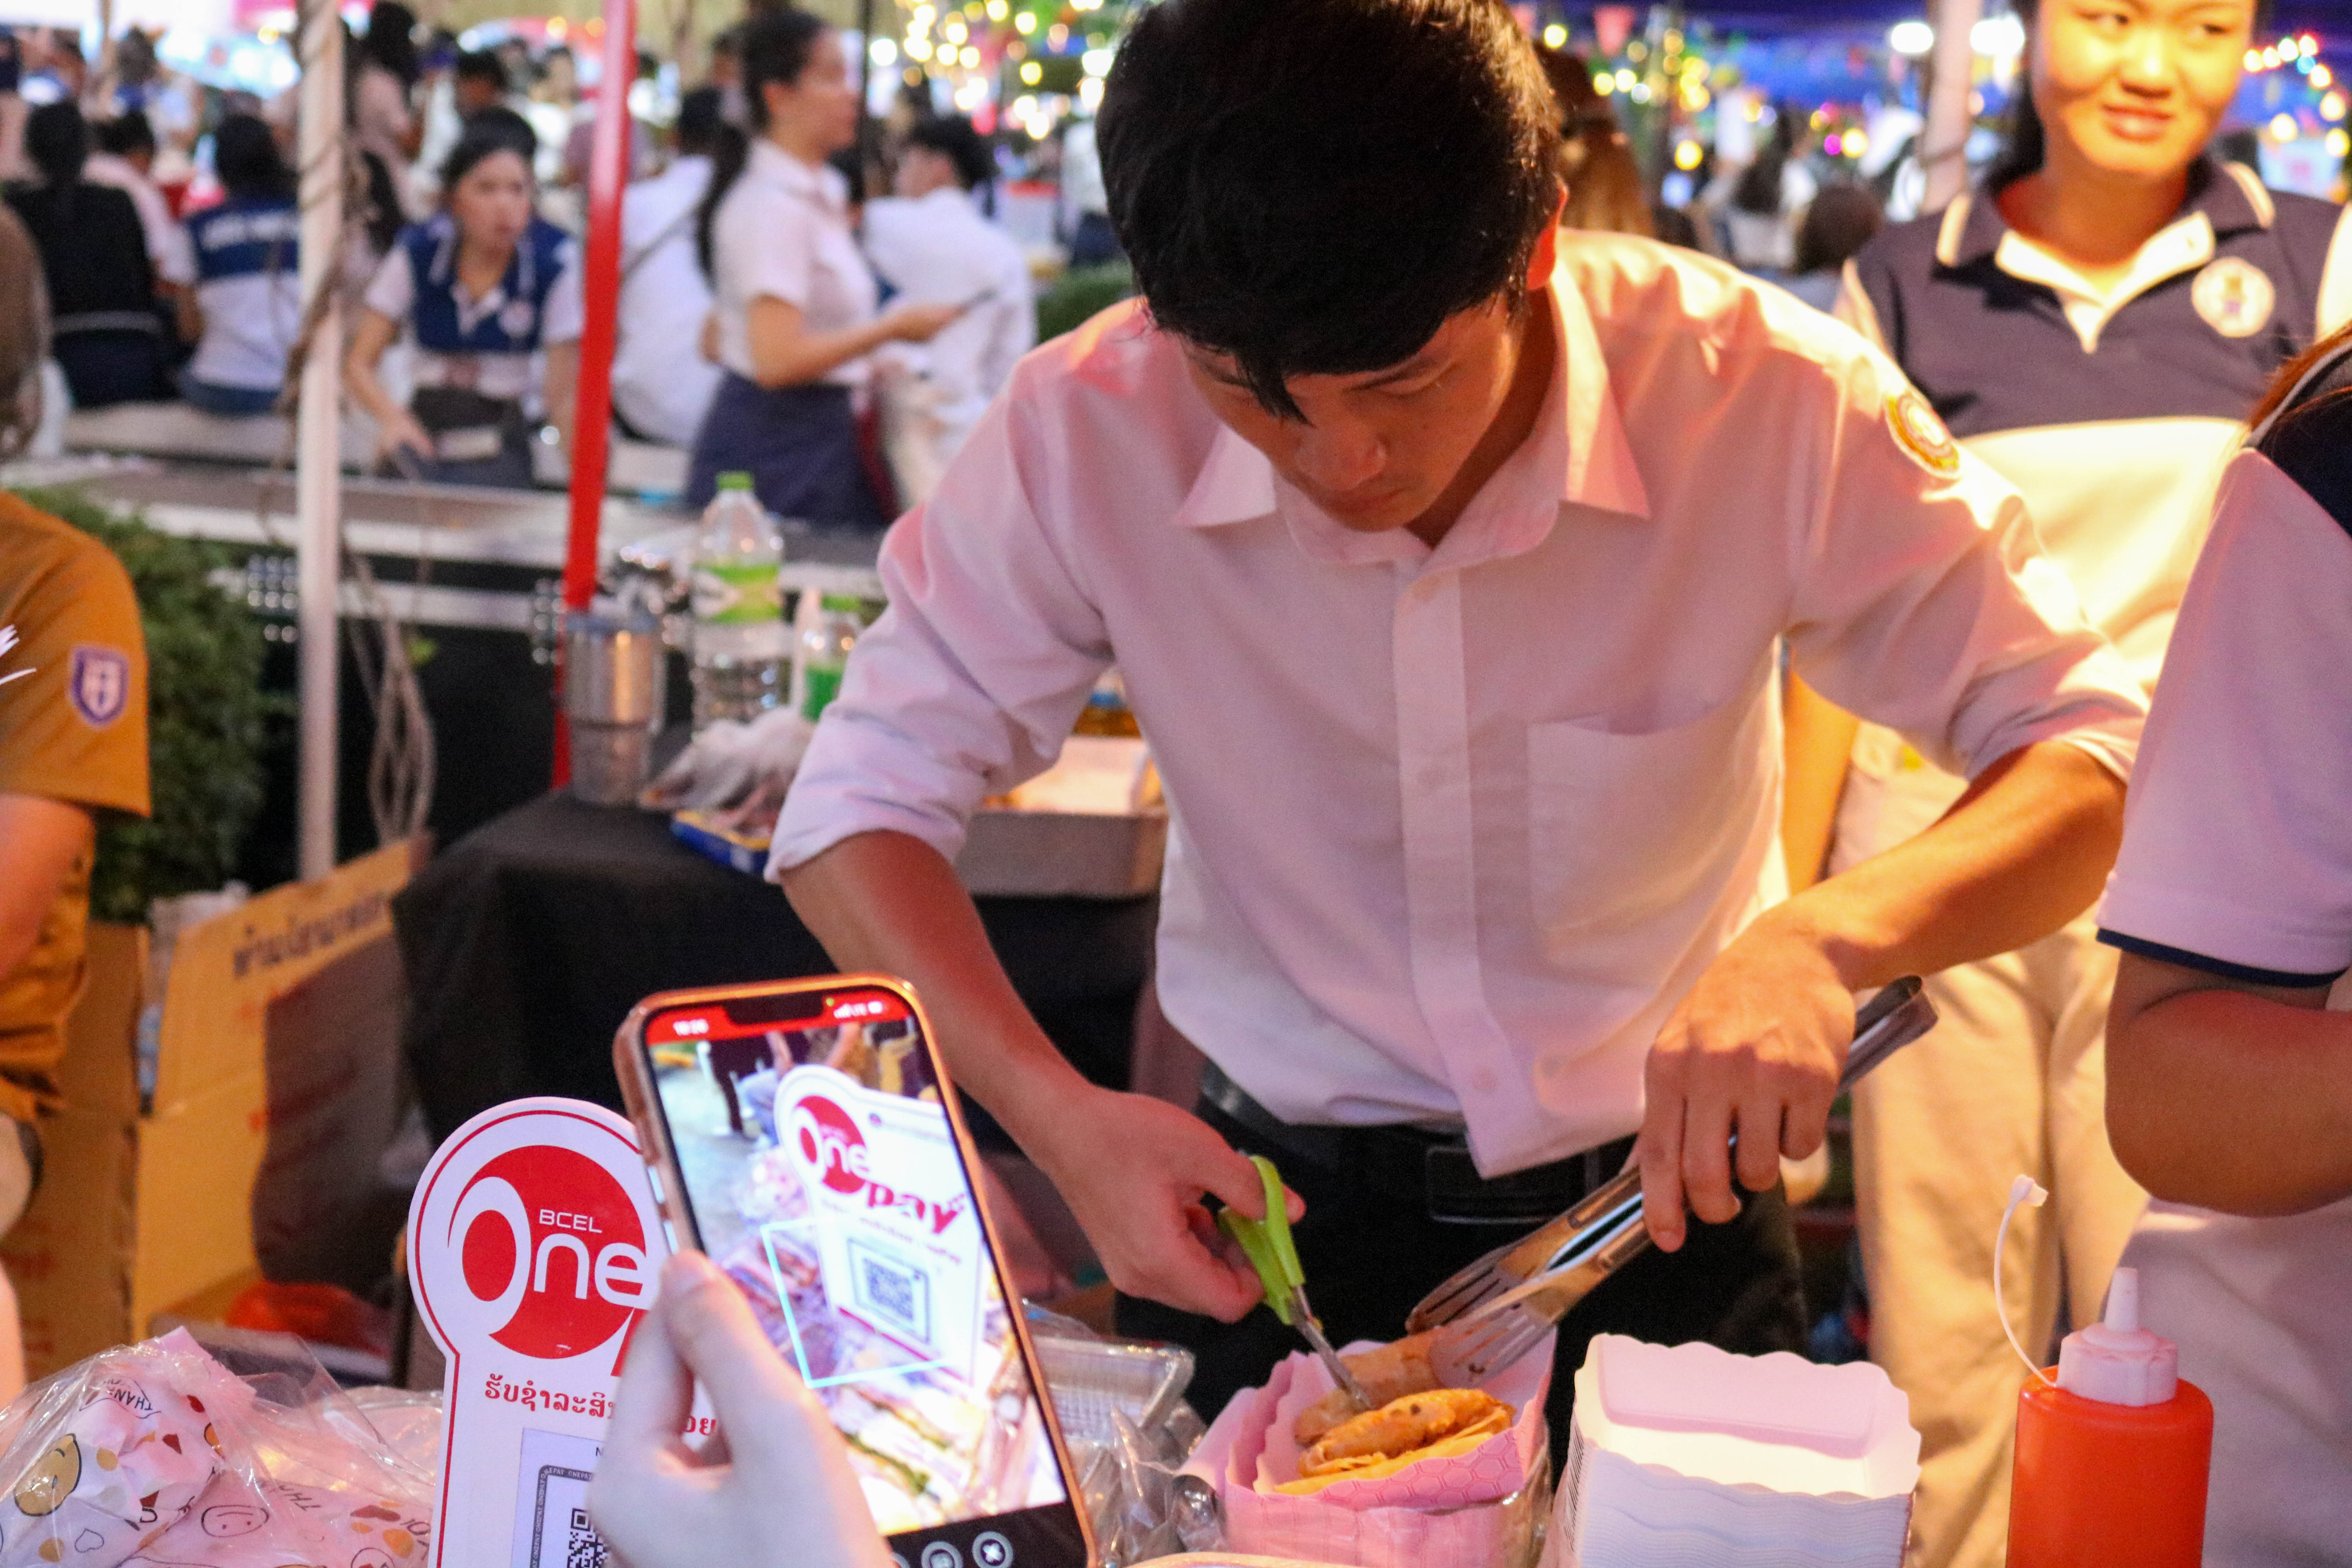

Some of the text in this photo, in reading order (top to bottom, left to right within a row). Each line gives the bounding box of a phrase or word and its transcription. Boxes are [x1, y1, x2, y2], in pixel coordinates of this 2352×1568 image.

[789, 1105, 871, 1183] One
[539, 1209, 603, 1233] BCEL
[866, 1181, 966, 1234] pay
[448, 1175, 650, 1335] One
[110, 1388, 152, 1410] THAN
